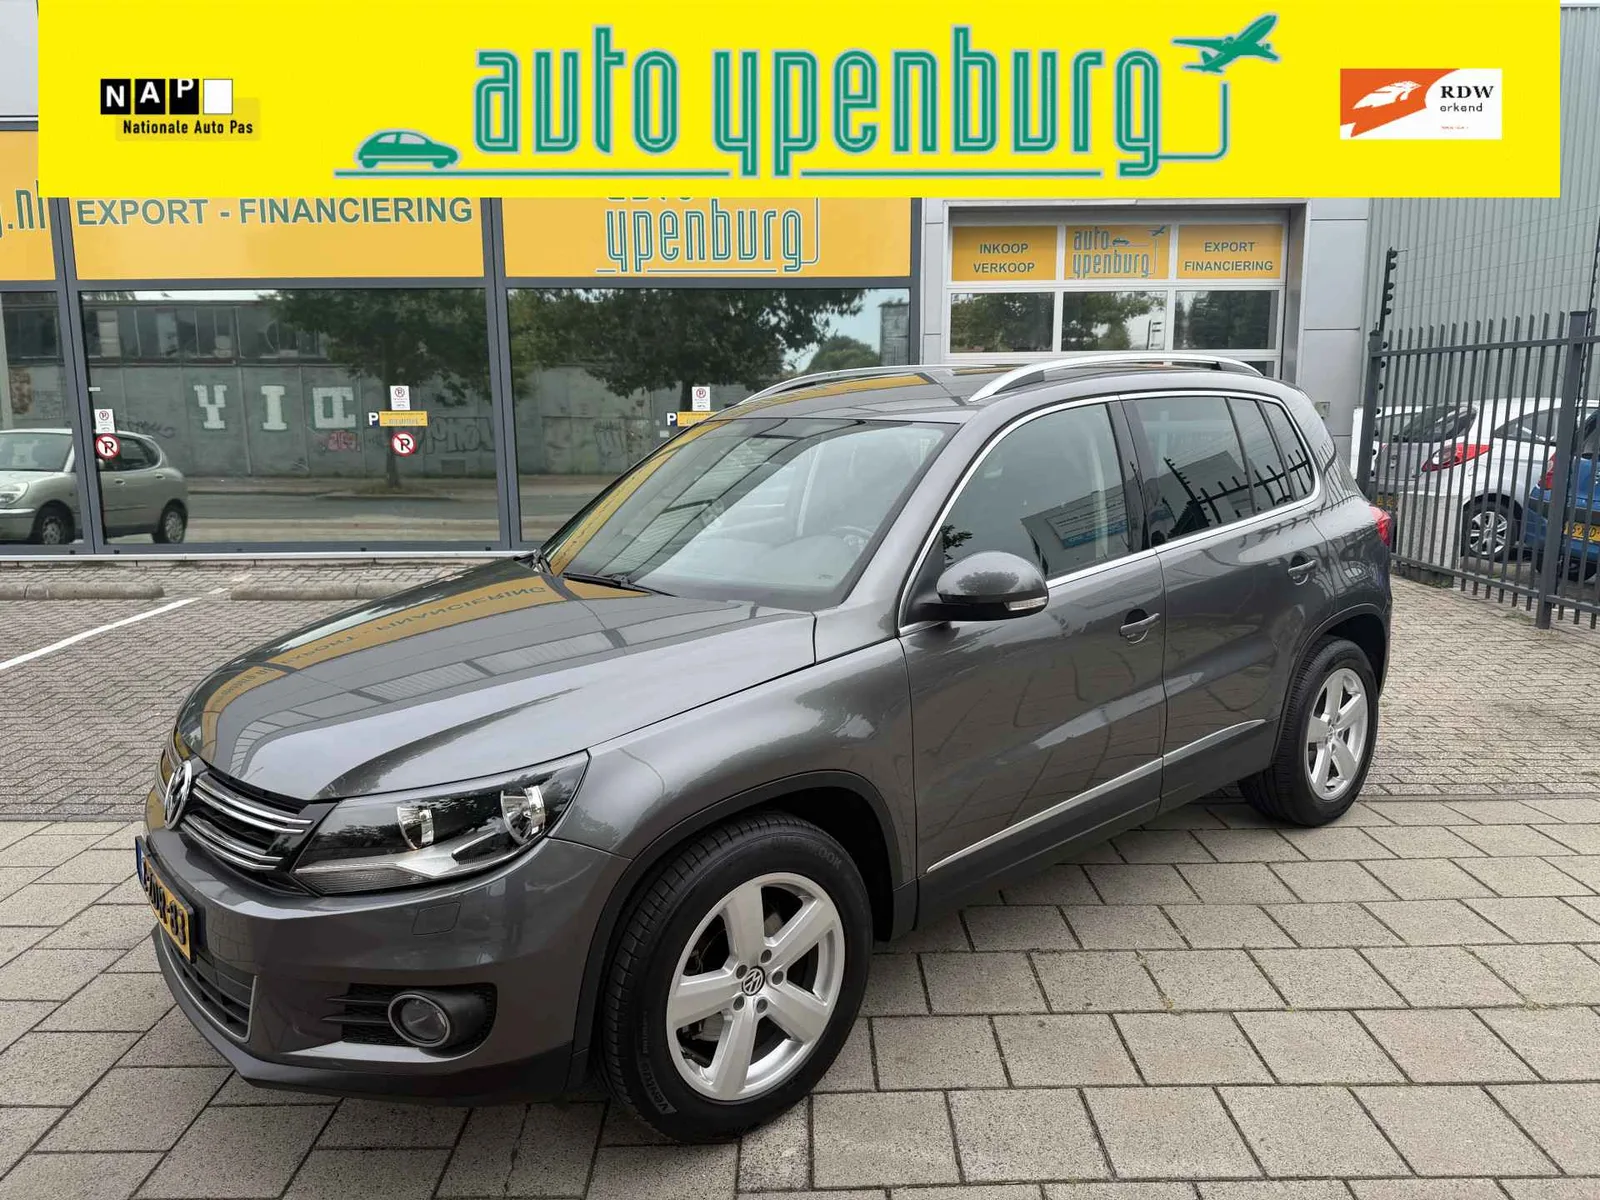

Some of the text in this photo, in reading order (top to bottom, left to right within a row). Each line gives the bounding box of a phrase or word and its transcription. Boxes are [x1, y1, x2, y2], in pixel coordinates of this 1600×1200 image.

[76, 199, 208, 226] EXPORT
[240, 197, 473, 225] FINANCIERING
[606, 198, 802, 273] ypenburg
[1073, 226, 1110, 251] auto
[979, 243, 1029, 255] INKOOP
[1204, 241, 1256, 253] EXPORT
[973, 262, 1036, 274] VERKOOP
[1072, 250, 1150, 278] ypenburg
[1184, 260, 1274, 272] FINANCIERING
